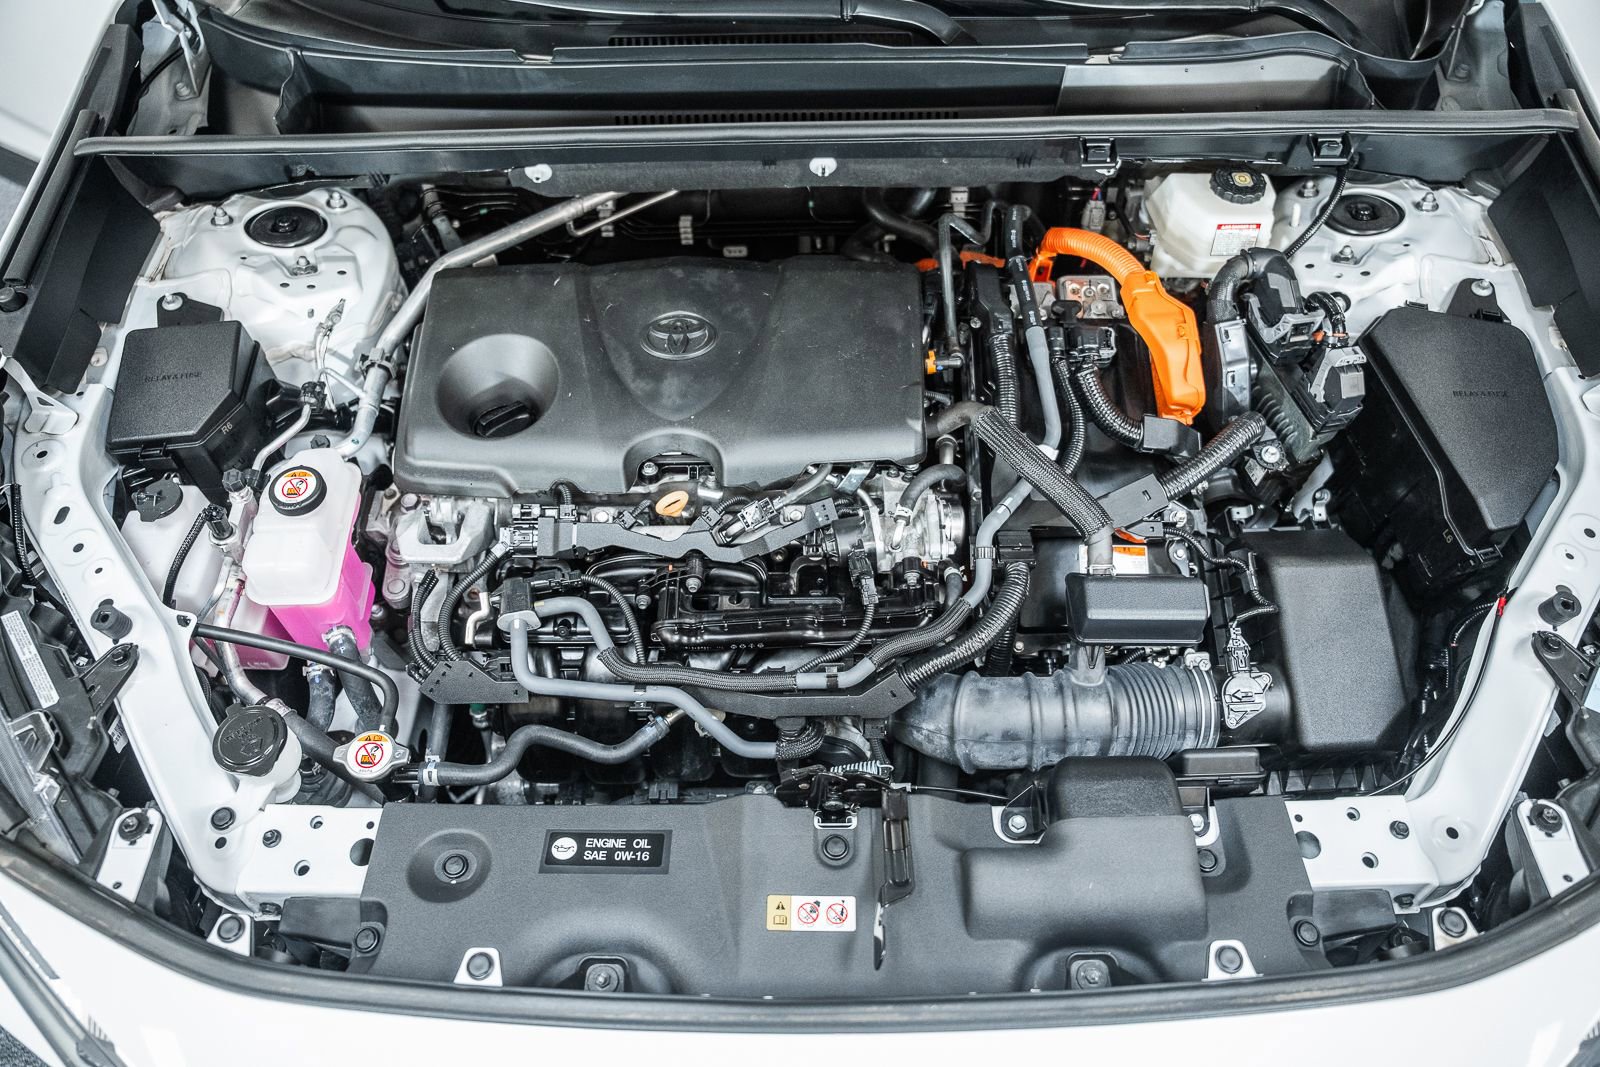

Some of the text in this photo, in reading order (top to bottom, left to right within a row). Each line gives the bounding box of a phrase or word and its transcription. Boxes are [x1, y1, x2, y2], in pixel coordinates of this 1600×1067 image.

[221, 421, 233, 434] R6
[585, 838, 651, 849] ENGINE OIL
[583, 850, 650, 861] SAE 0W-16
